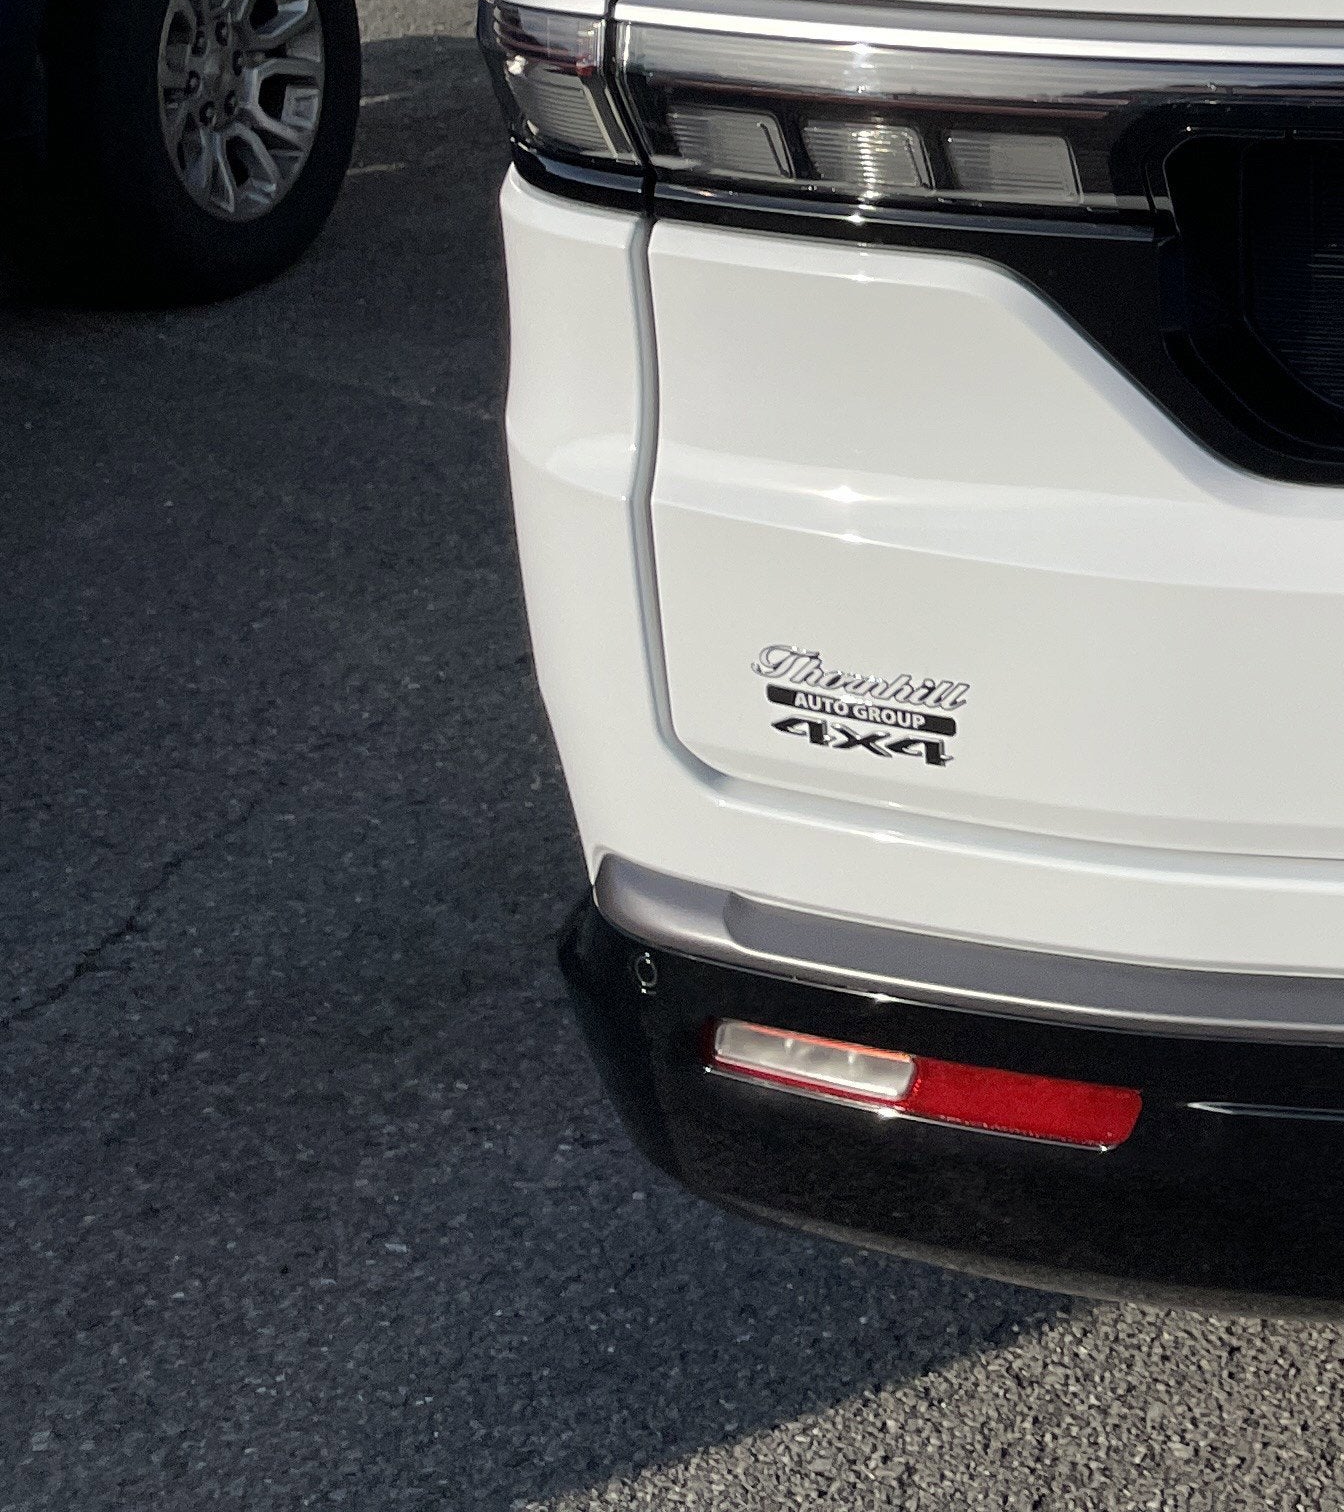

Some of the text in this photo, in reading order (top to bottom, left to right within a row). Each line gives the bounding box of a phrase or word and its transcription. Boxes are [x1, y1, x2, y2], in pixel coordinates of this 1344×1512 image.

[750, 643, 971, 711] Thornhill
[794, 691, 926, 729] AUTO GROUP
